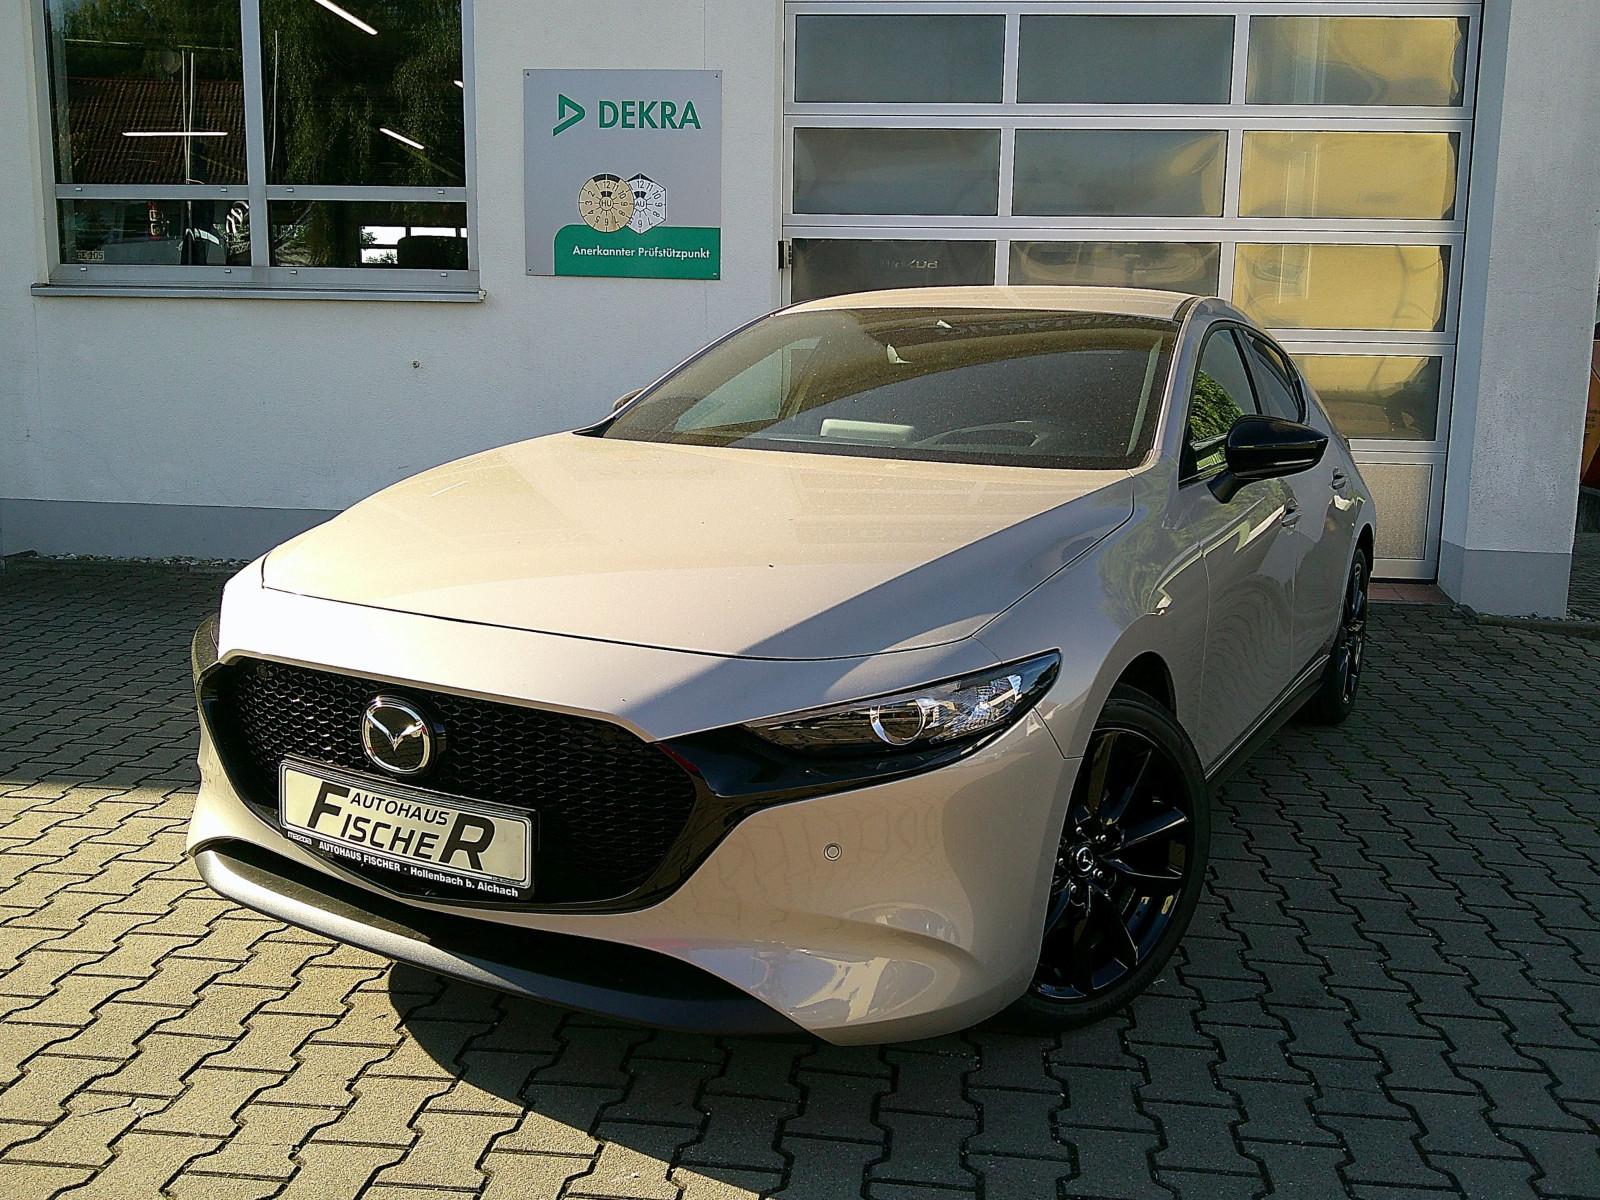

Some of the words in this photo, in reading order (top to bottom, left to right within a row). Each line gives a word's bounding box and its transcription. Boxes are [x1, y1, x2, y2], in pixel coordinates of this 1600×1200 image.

[599, 100, 702, 130] DEKRA
[572, 245, 635, 257] Anerkannter
[638, 246, 711, 260] Prüfstützpunkt
[350, 793, 450, 825] AUTOHAUS
[287, 831, 312, 846] mazda
[307, 781, 496, 871] FISCHER
[318, 841, 362, 861] AUTOHAUS
[363, 854, 401, 872] FISCHER
[410, 866, 464, 886] Hollenbach
[465, 879, 476, 889] b.
[477, 881, 519, 897] Aichach
